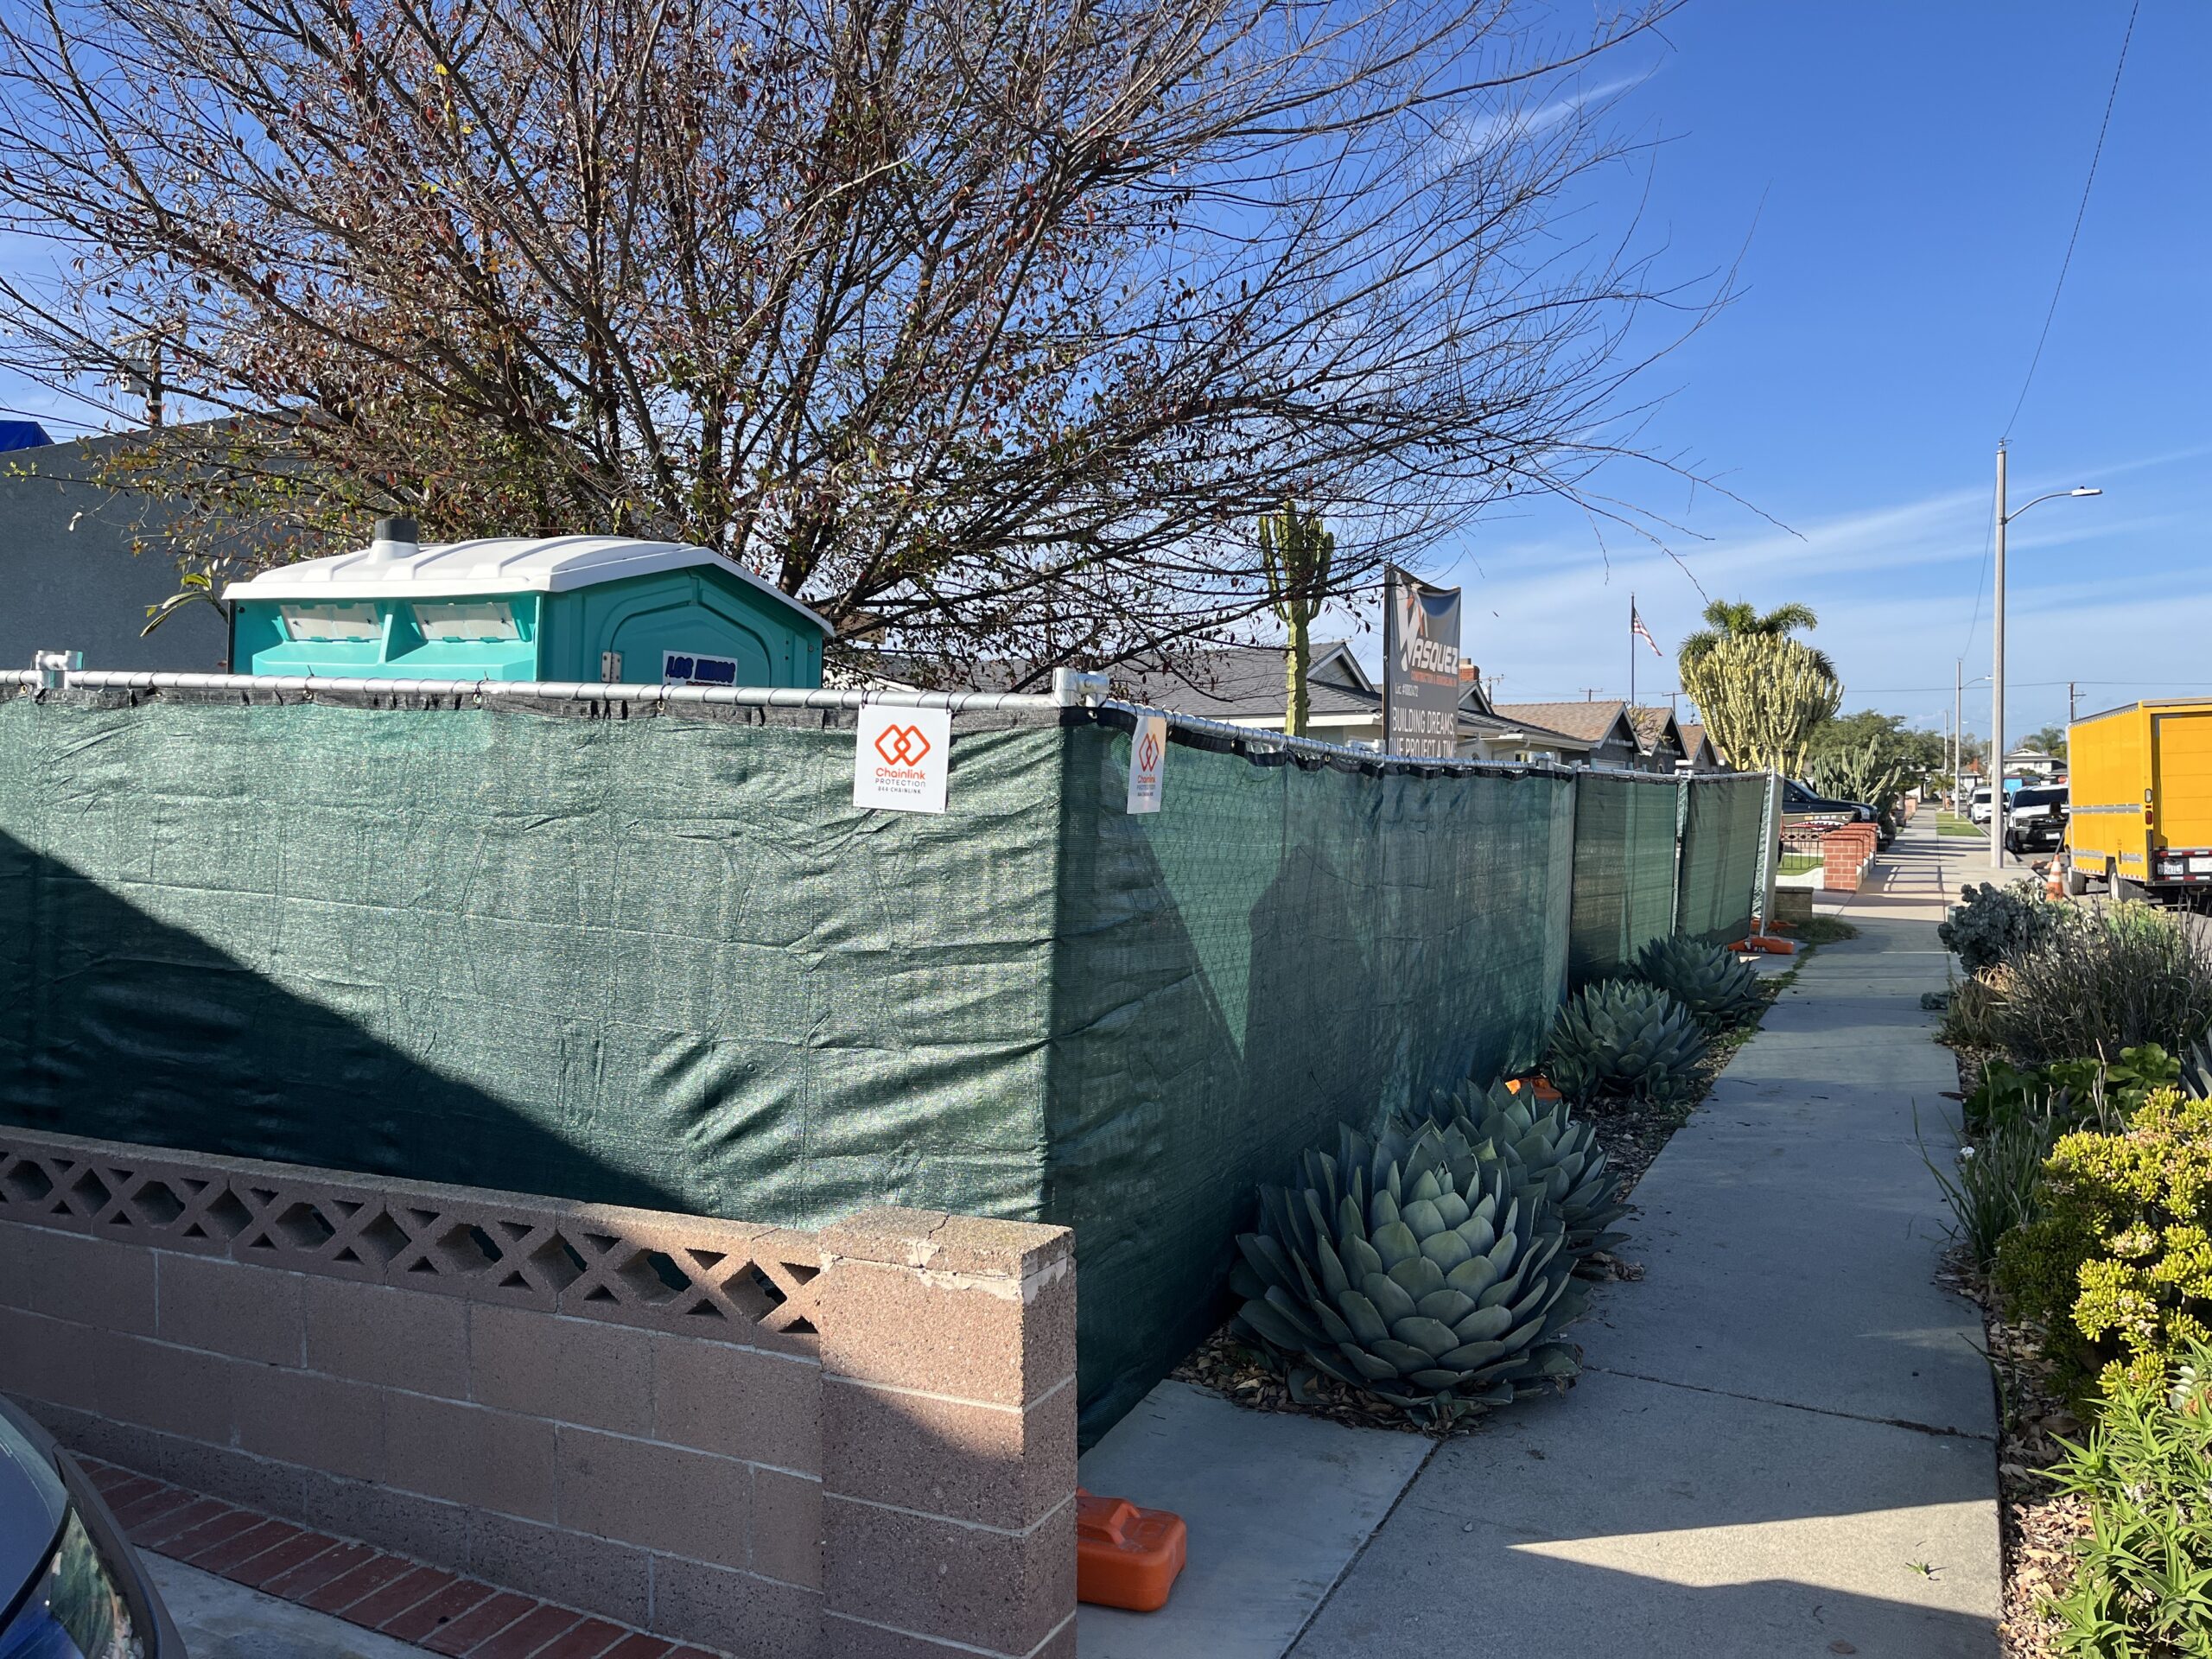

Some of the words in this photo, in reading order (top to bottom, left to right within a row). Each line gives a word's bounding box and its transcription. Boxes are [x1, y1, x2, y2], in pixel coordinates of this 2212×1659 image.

[1393, 706, 1426, 734] BUILDING
[1427, 709, 1455, 739] DREAMS,
[875, 767, 925, 779] Chainlink
[874, 778, 926, 787] PROTECTION
